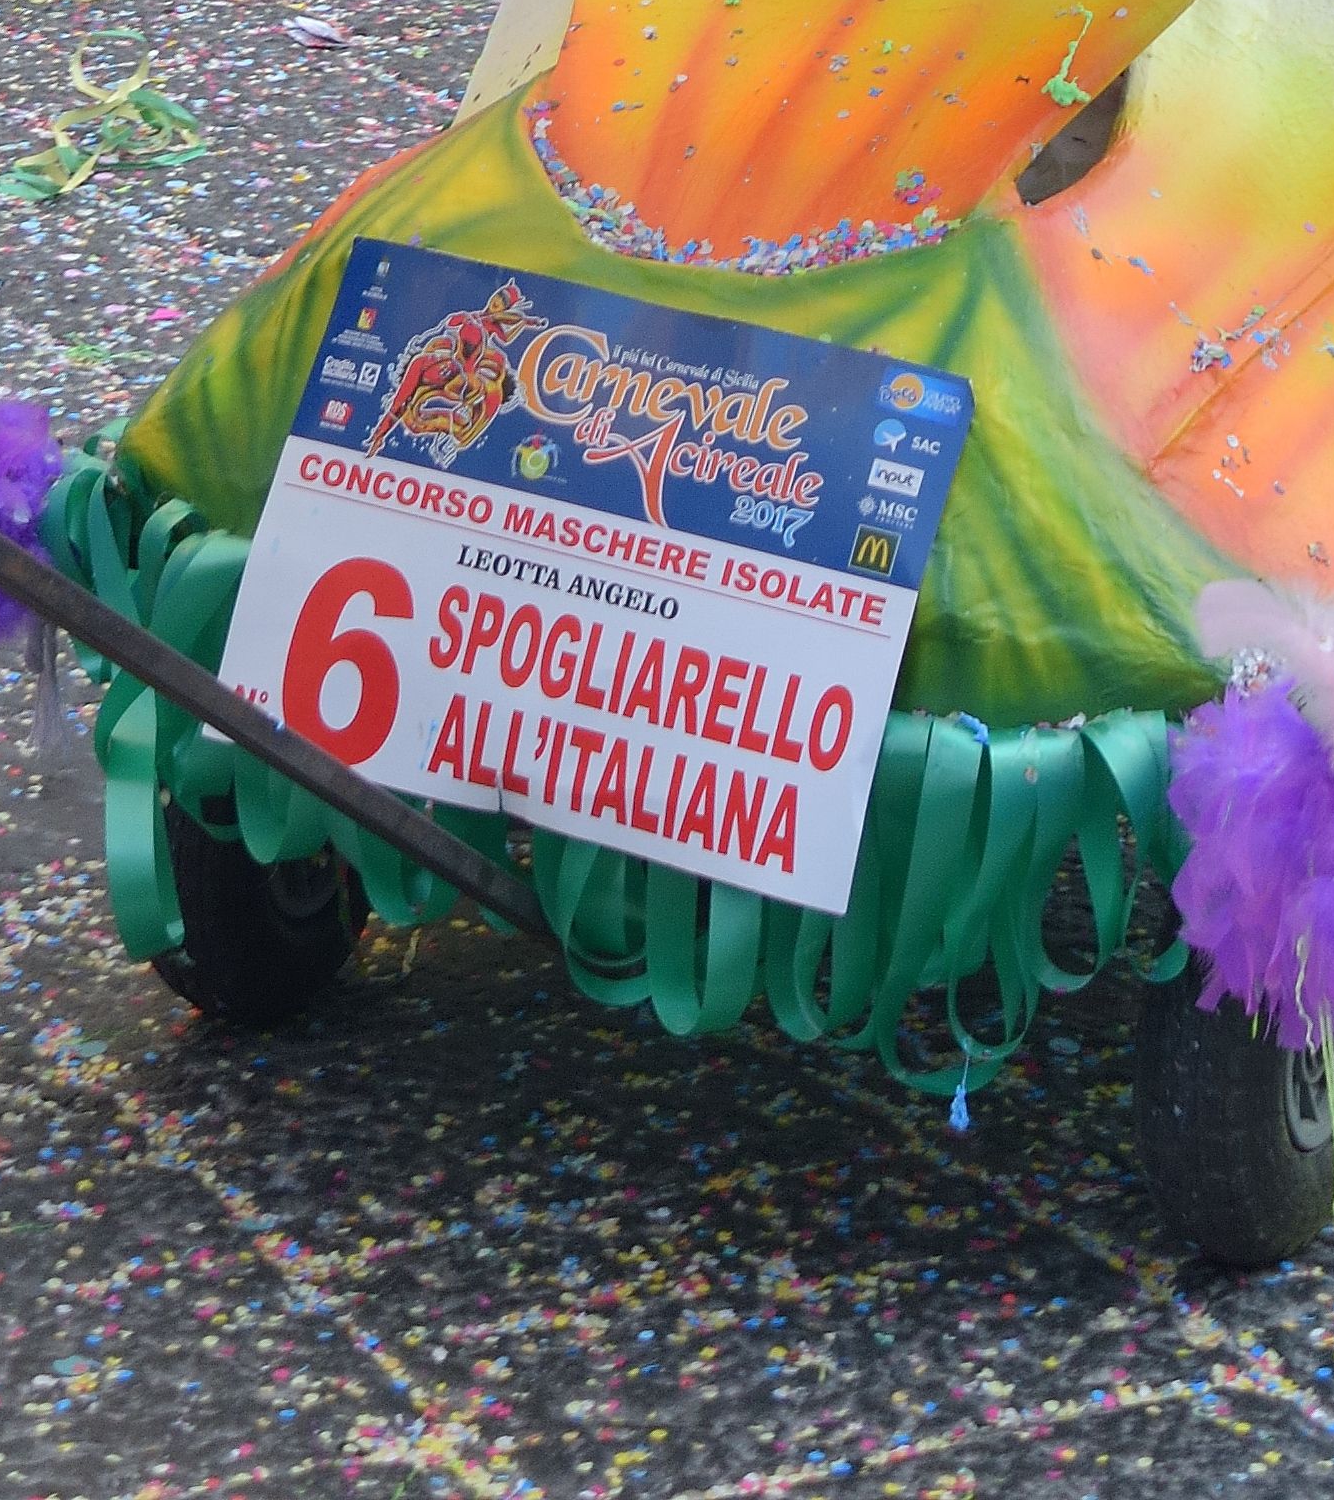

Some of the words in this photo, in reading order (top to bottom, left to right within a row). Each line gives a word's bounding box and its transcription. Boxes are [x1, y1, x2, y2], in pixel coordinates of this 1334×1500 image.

[518, 324, 809, 450] Carnevale
[573, 406, 617, 448] di
[910, 435, 942, 455] SAC
[582, 411, 824, 527] Acireale
[729, 494, 816, 550] 2017
[875, 498, 919, 523] MSC
[299, 453, 494, 524] CONCORSO
[502, 502, 712, 581] MASCHERE
[720, 558, 887, 626] ISOLATE
[457, 544, 561, 590] LEOTTA
[567, 574, 680, 620] ANGELO
[280, 556, 415, 767] 6
[428, 583, 854, 772] SPOGLIARELLO
[426, 693, 800, 875] ALL'ITALIANA
